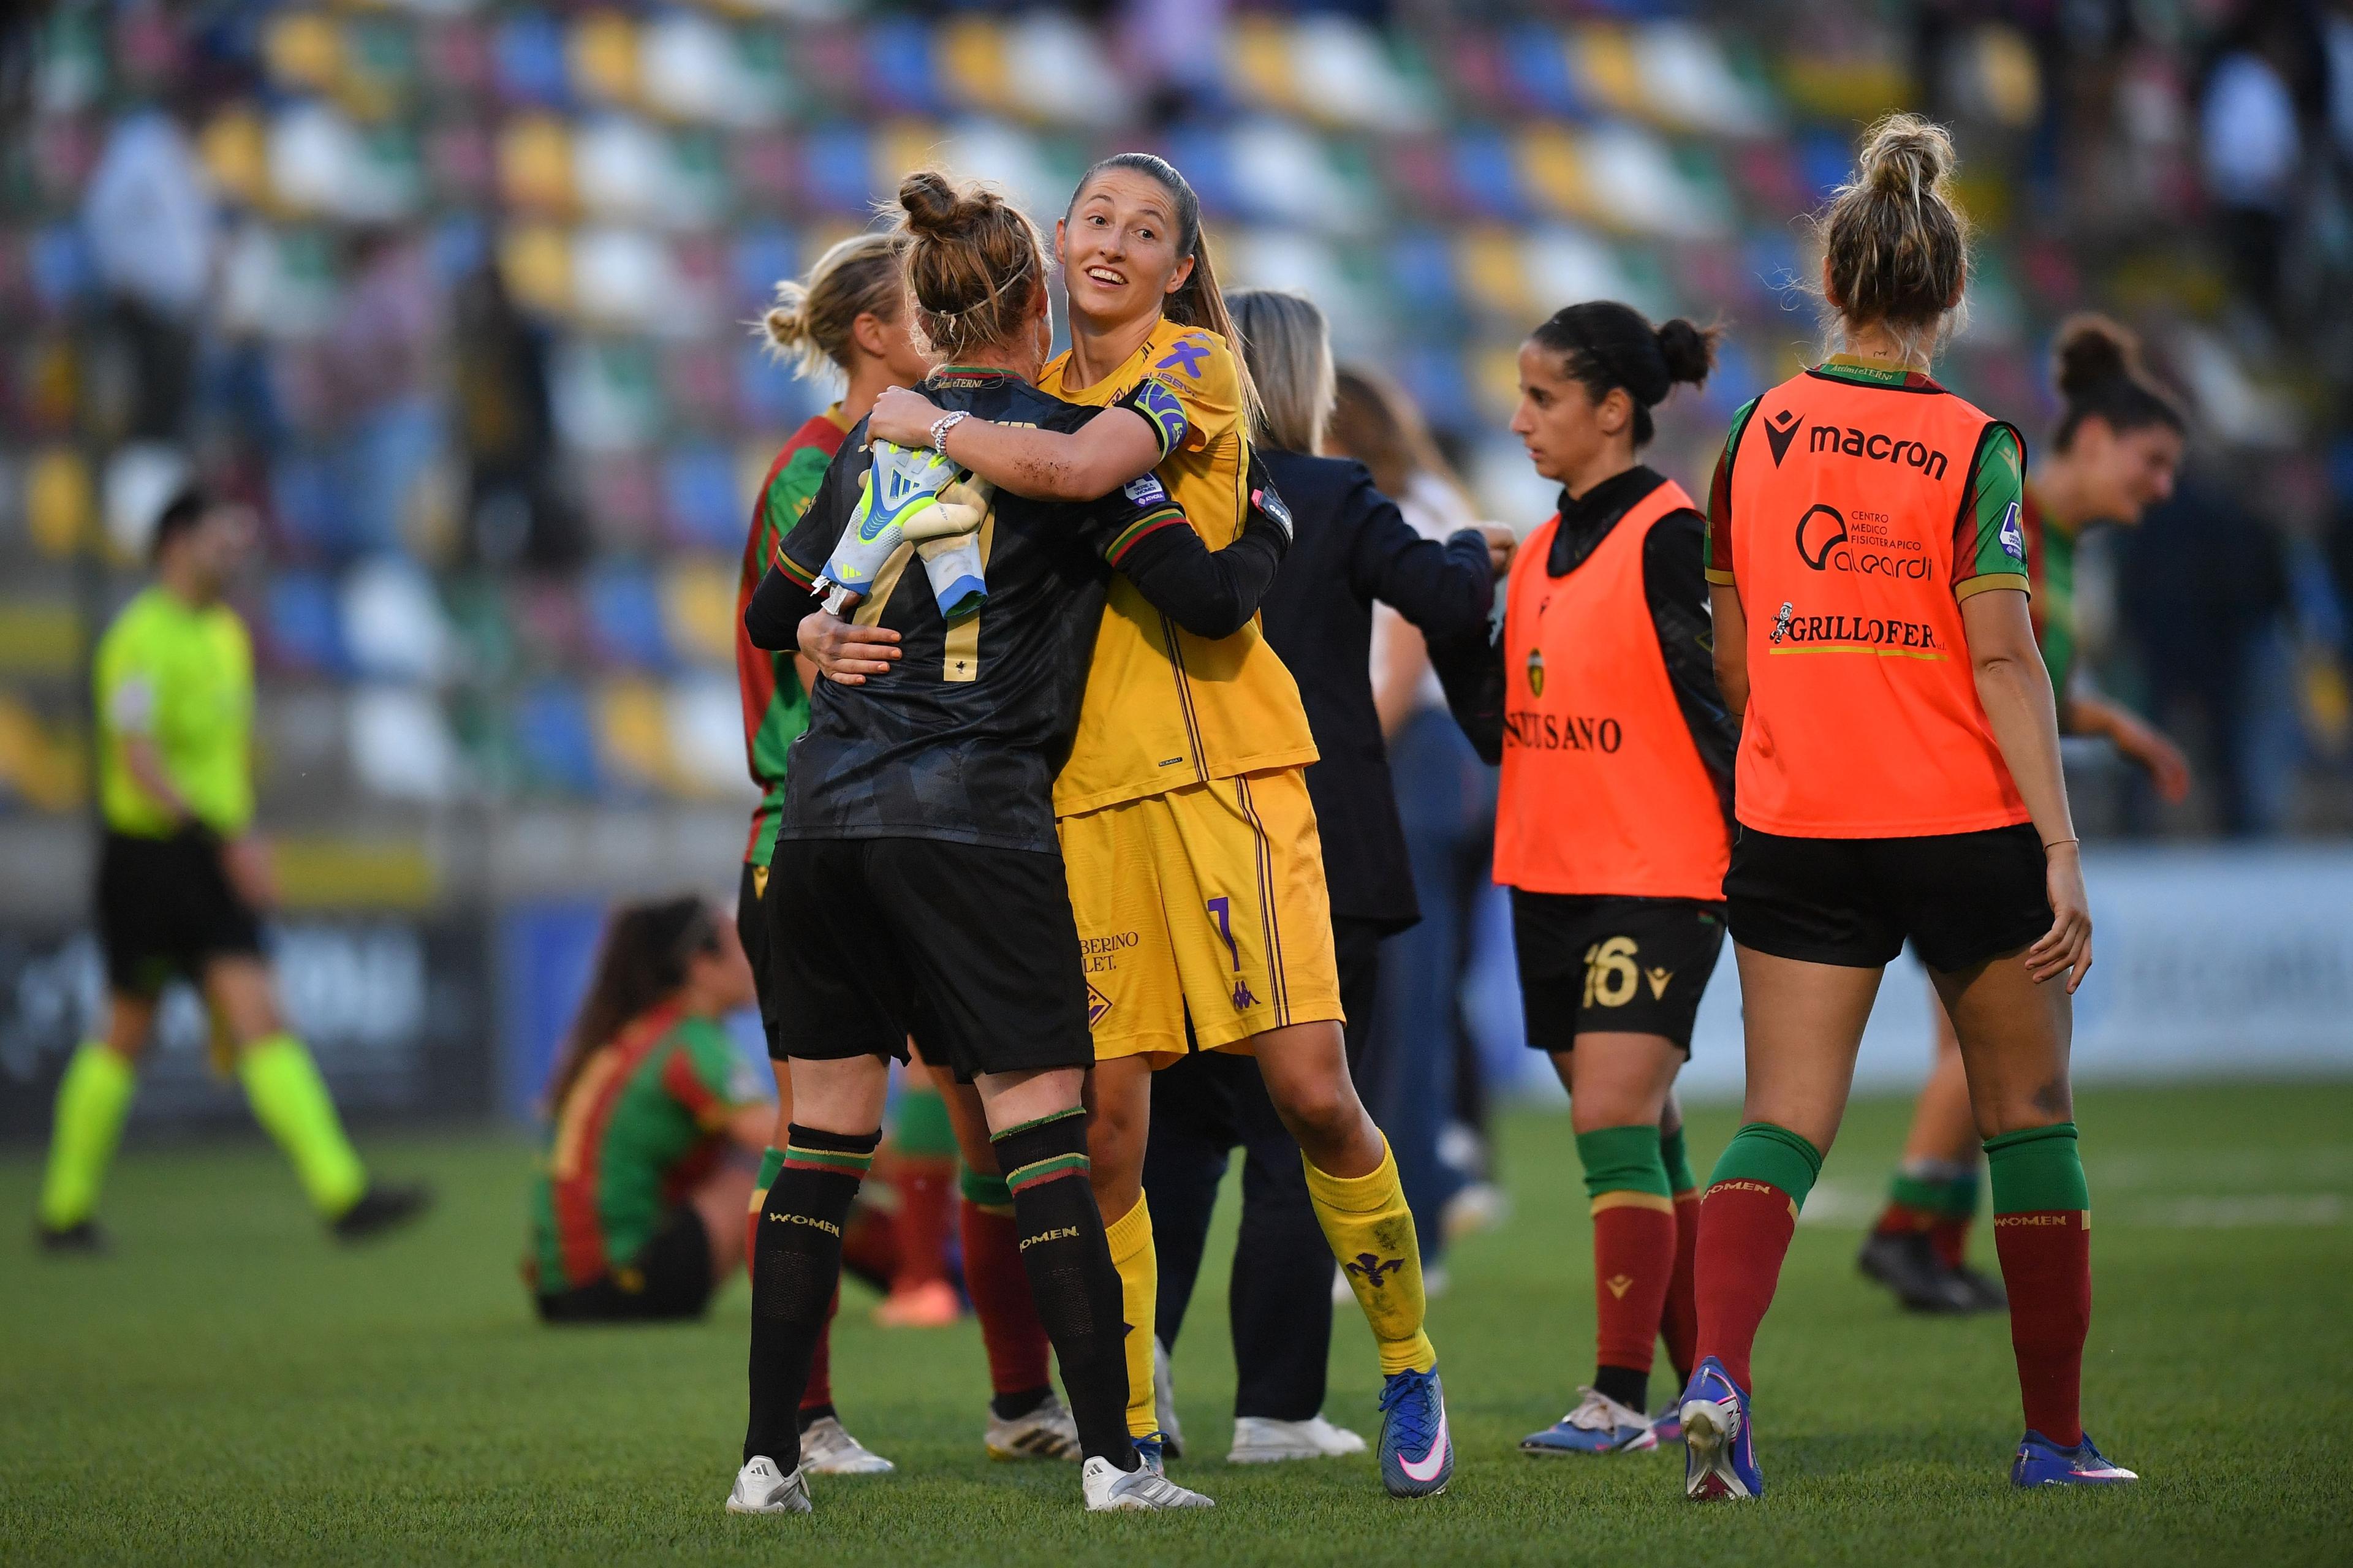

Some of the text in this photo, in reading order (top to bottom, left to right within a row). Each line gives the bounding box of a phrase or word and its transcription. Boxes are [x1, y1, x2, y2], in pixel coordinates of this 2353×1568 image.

[1809, 426, 1949, 481] macron
[1851, 510, 1889, 523] CENTRO
[1851, 523, 1888, 536] MEDICO
[1851, 535, 1922, 551] FISIOTERAPICO
[1789, 616, 1936, 648] GRILLOFER
[1207, 896, 1241, 972] 7
[1582, 935, 1639, 1009] 16
[770, 1213, 840, 1238] WOMEN
[1020, 1225, 1077, 1253] OMEN
